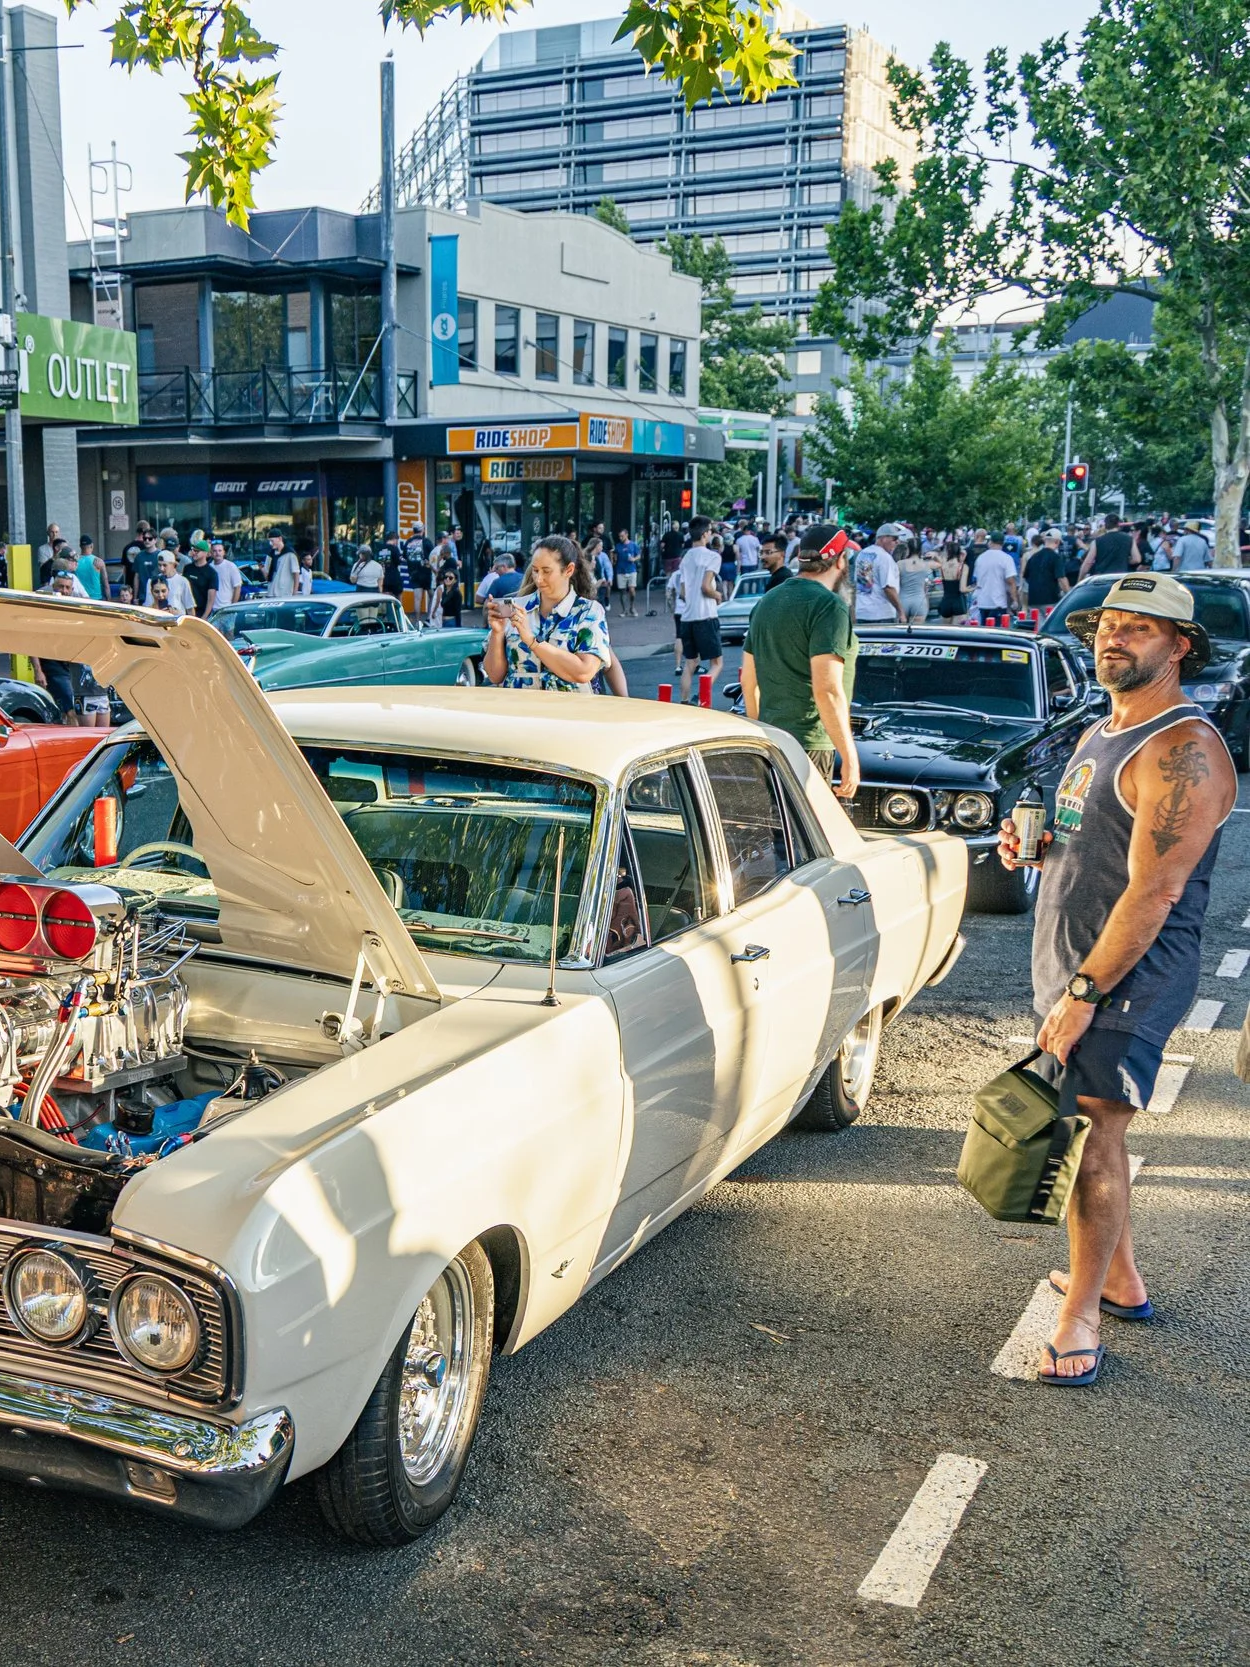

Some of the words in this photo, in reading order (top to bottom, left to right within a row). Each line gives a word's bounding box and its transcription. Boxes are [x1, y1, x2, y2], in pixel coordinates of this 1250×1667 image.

[48, 353, 131, 405] OUTLET
[474, 427, 550, 450] RIDESHOP
[588, 416, 627, 448] RIDESHOP
[489, 459, 565, 479] RIDESHOP
[213, 481, 248, 492] GIANT
[257, 480, 313, 492] GIANT
[904, 645, 943, 657] 2710
